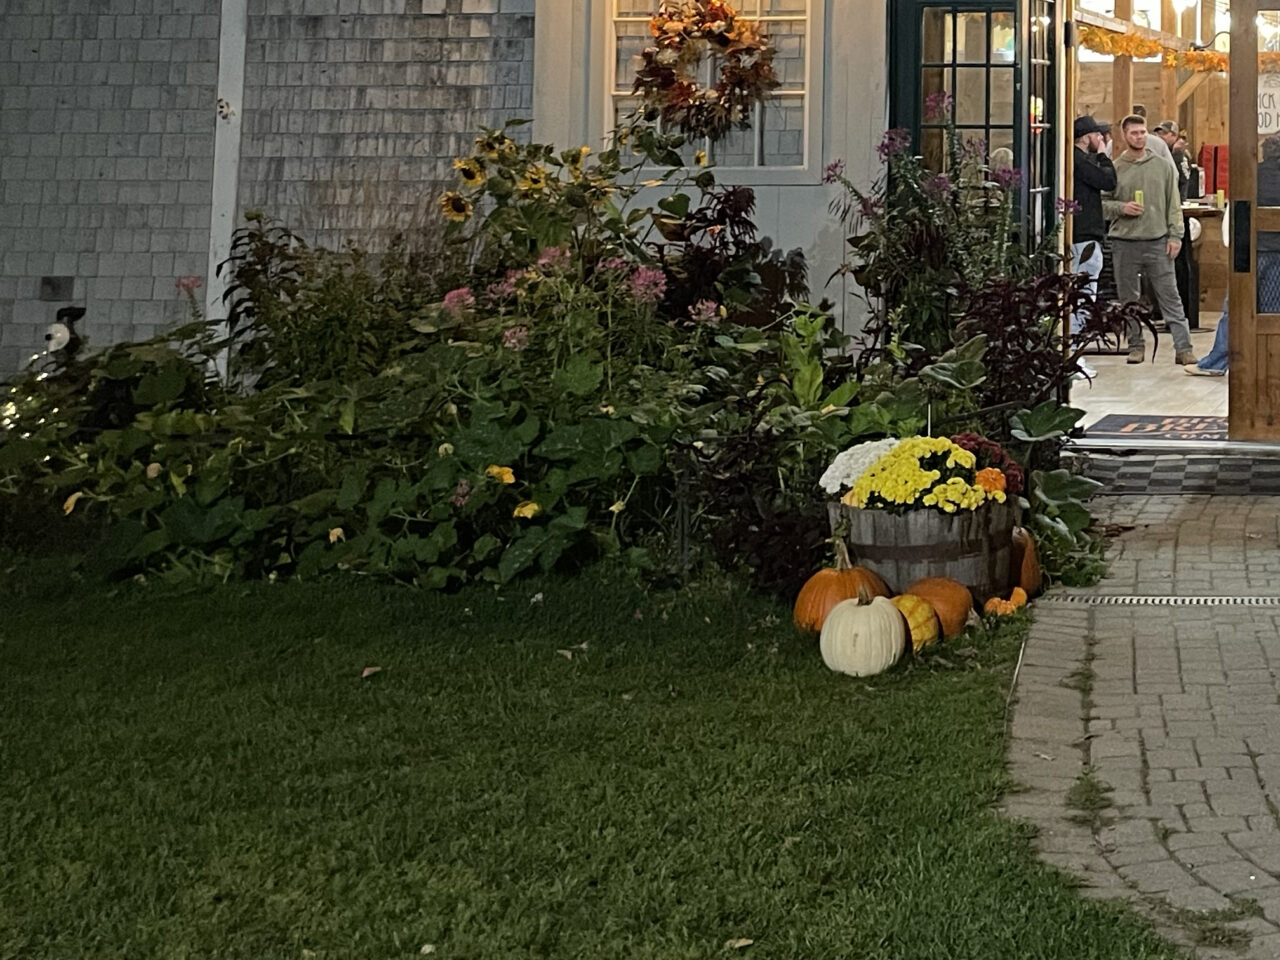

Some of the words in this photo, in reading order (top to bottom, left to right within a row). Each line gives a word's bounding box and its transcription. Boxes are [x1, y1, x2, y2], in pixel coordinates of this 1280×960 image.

[1258, 93, 1276, 109] ICK
[1258, 111, 1272, 128] OD
[1119, 422, 1228, 433] BRE
